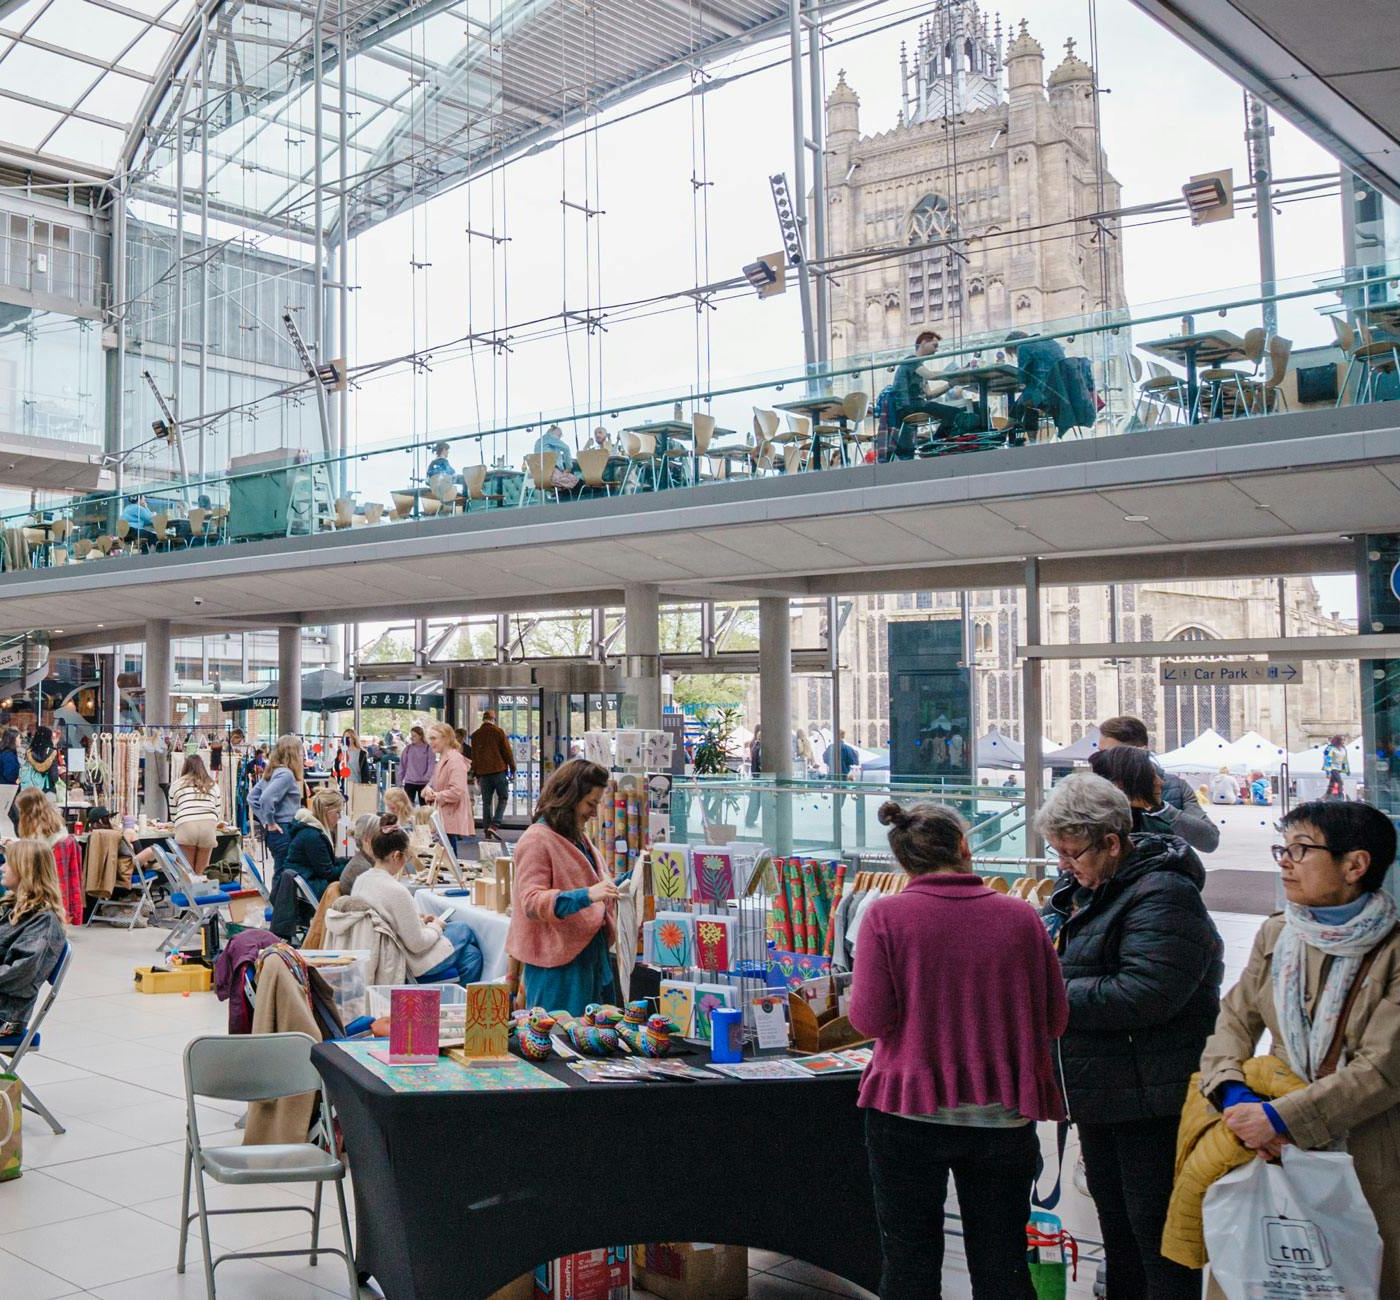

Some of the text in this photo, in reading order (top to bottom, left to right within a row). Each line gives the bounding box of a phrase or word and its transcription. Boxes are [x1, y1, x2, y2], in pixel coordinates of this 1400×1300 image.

[1194, 668, 1248, 679] Car Park
[253, 698, 279, 706] MARZA
[345, 696, 377, 705] CFE
[1280, 1244, 1314, 1261] tm
